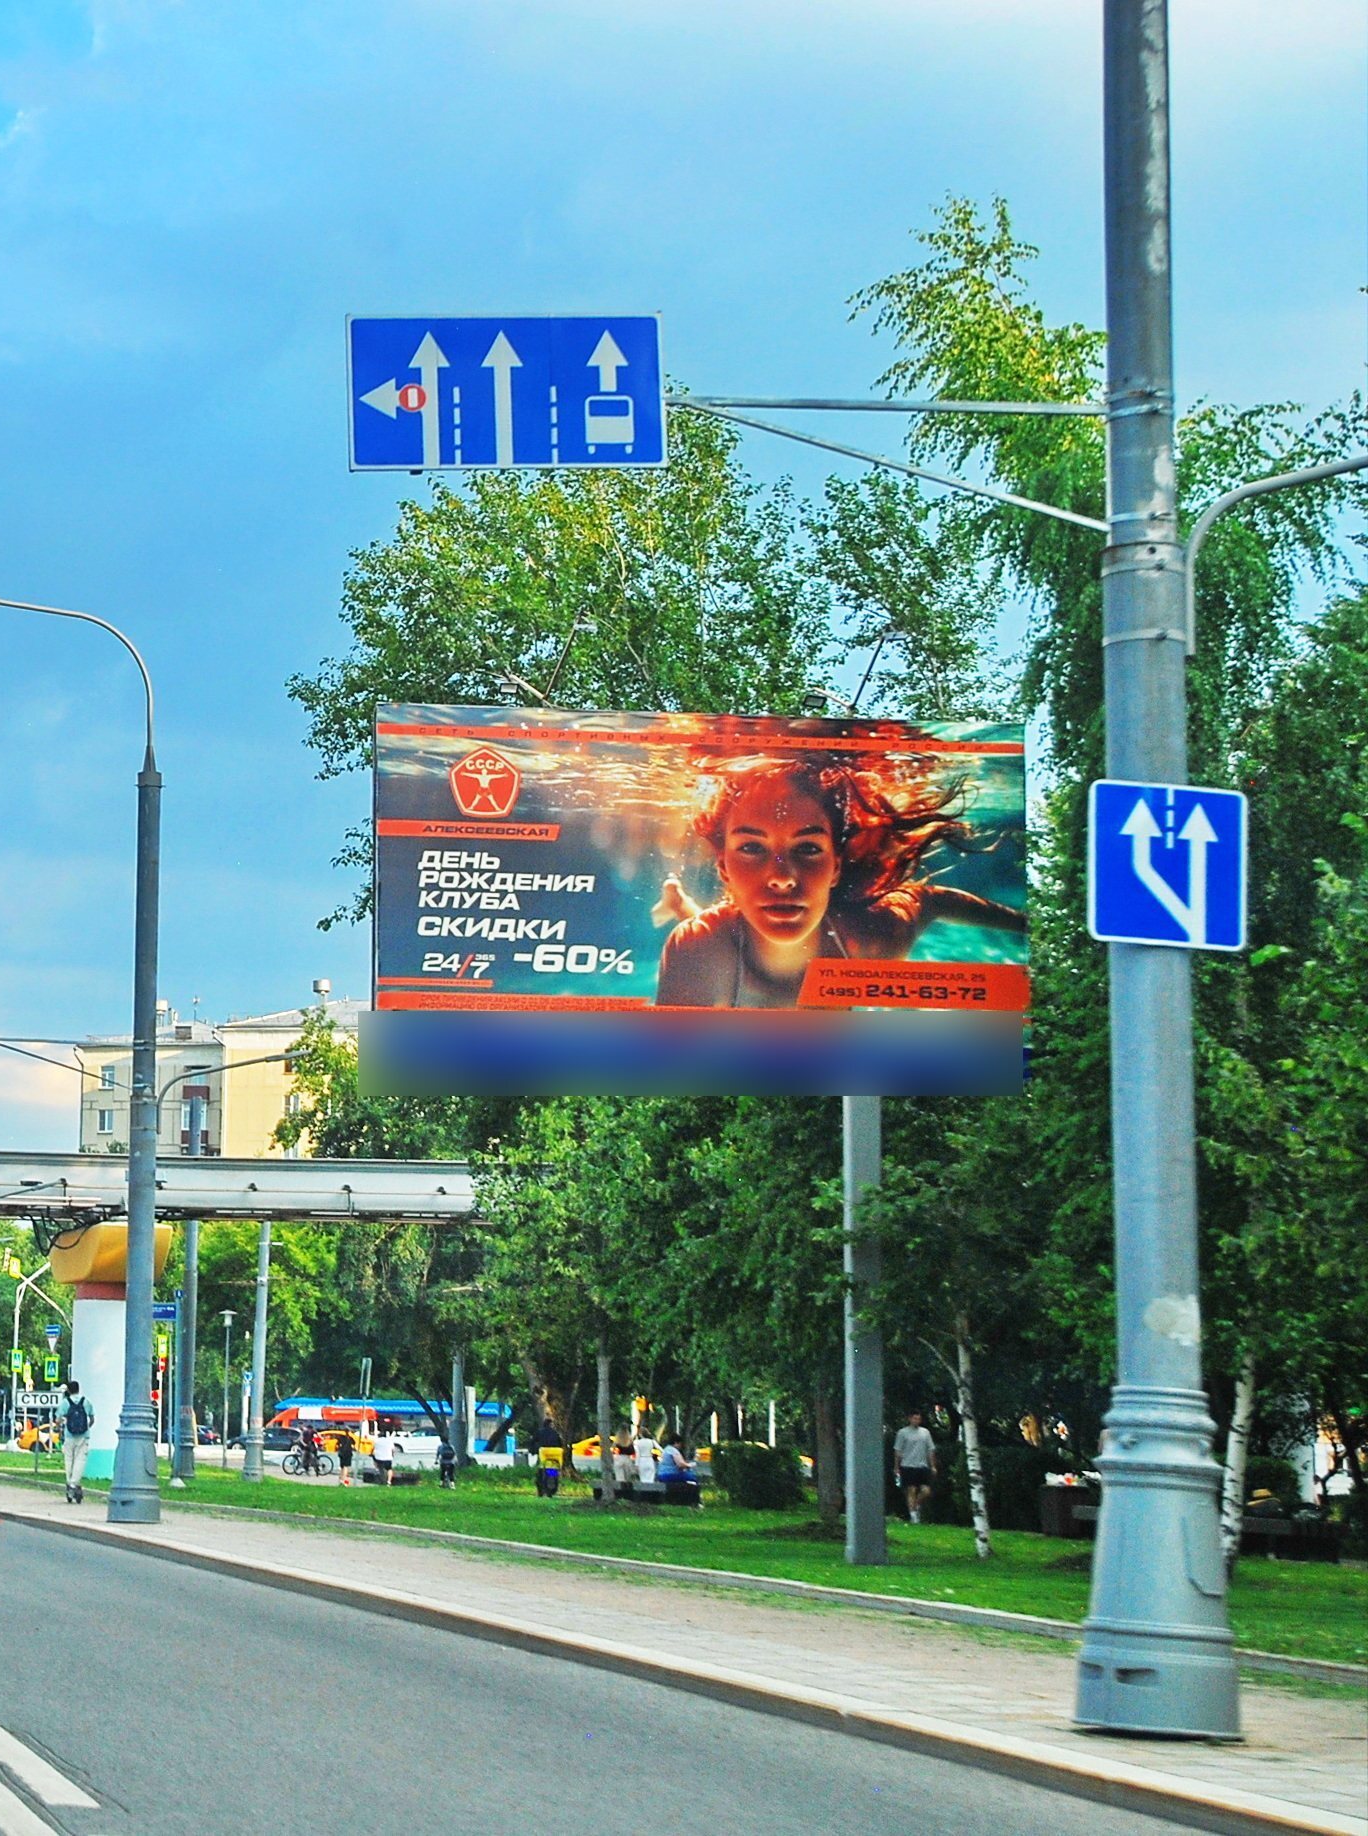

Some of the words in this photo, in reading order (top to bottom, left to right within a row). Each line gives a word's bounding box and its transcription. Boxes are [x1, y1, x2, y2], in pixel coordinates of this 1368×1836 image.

[418, 727, 475, 736] СЕТЬ
[507, 730, 666, 741] СПОРТИВНЫХ
[465, 759, 505, 771] СССР
[422, 825, 549, 837] АЛЕКСЕЕВСКАЯ
[417, 850, 501, 870] ДЕНЬ
[418, 870, 595, 893] РОЖДЕНИЯ
[418, 891, 521, 911] КЛУБА
[417, 915, 567, 942] СКИДКИ
[421, 952, 490, 979] 24/7
[513, 943, 635, 975] -60%
[866, 984, 987, 1001] 241-63-72
[21, 1393, 59, 1405] СТОП
